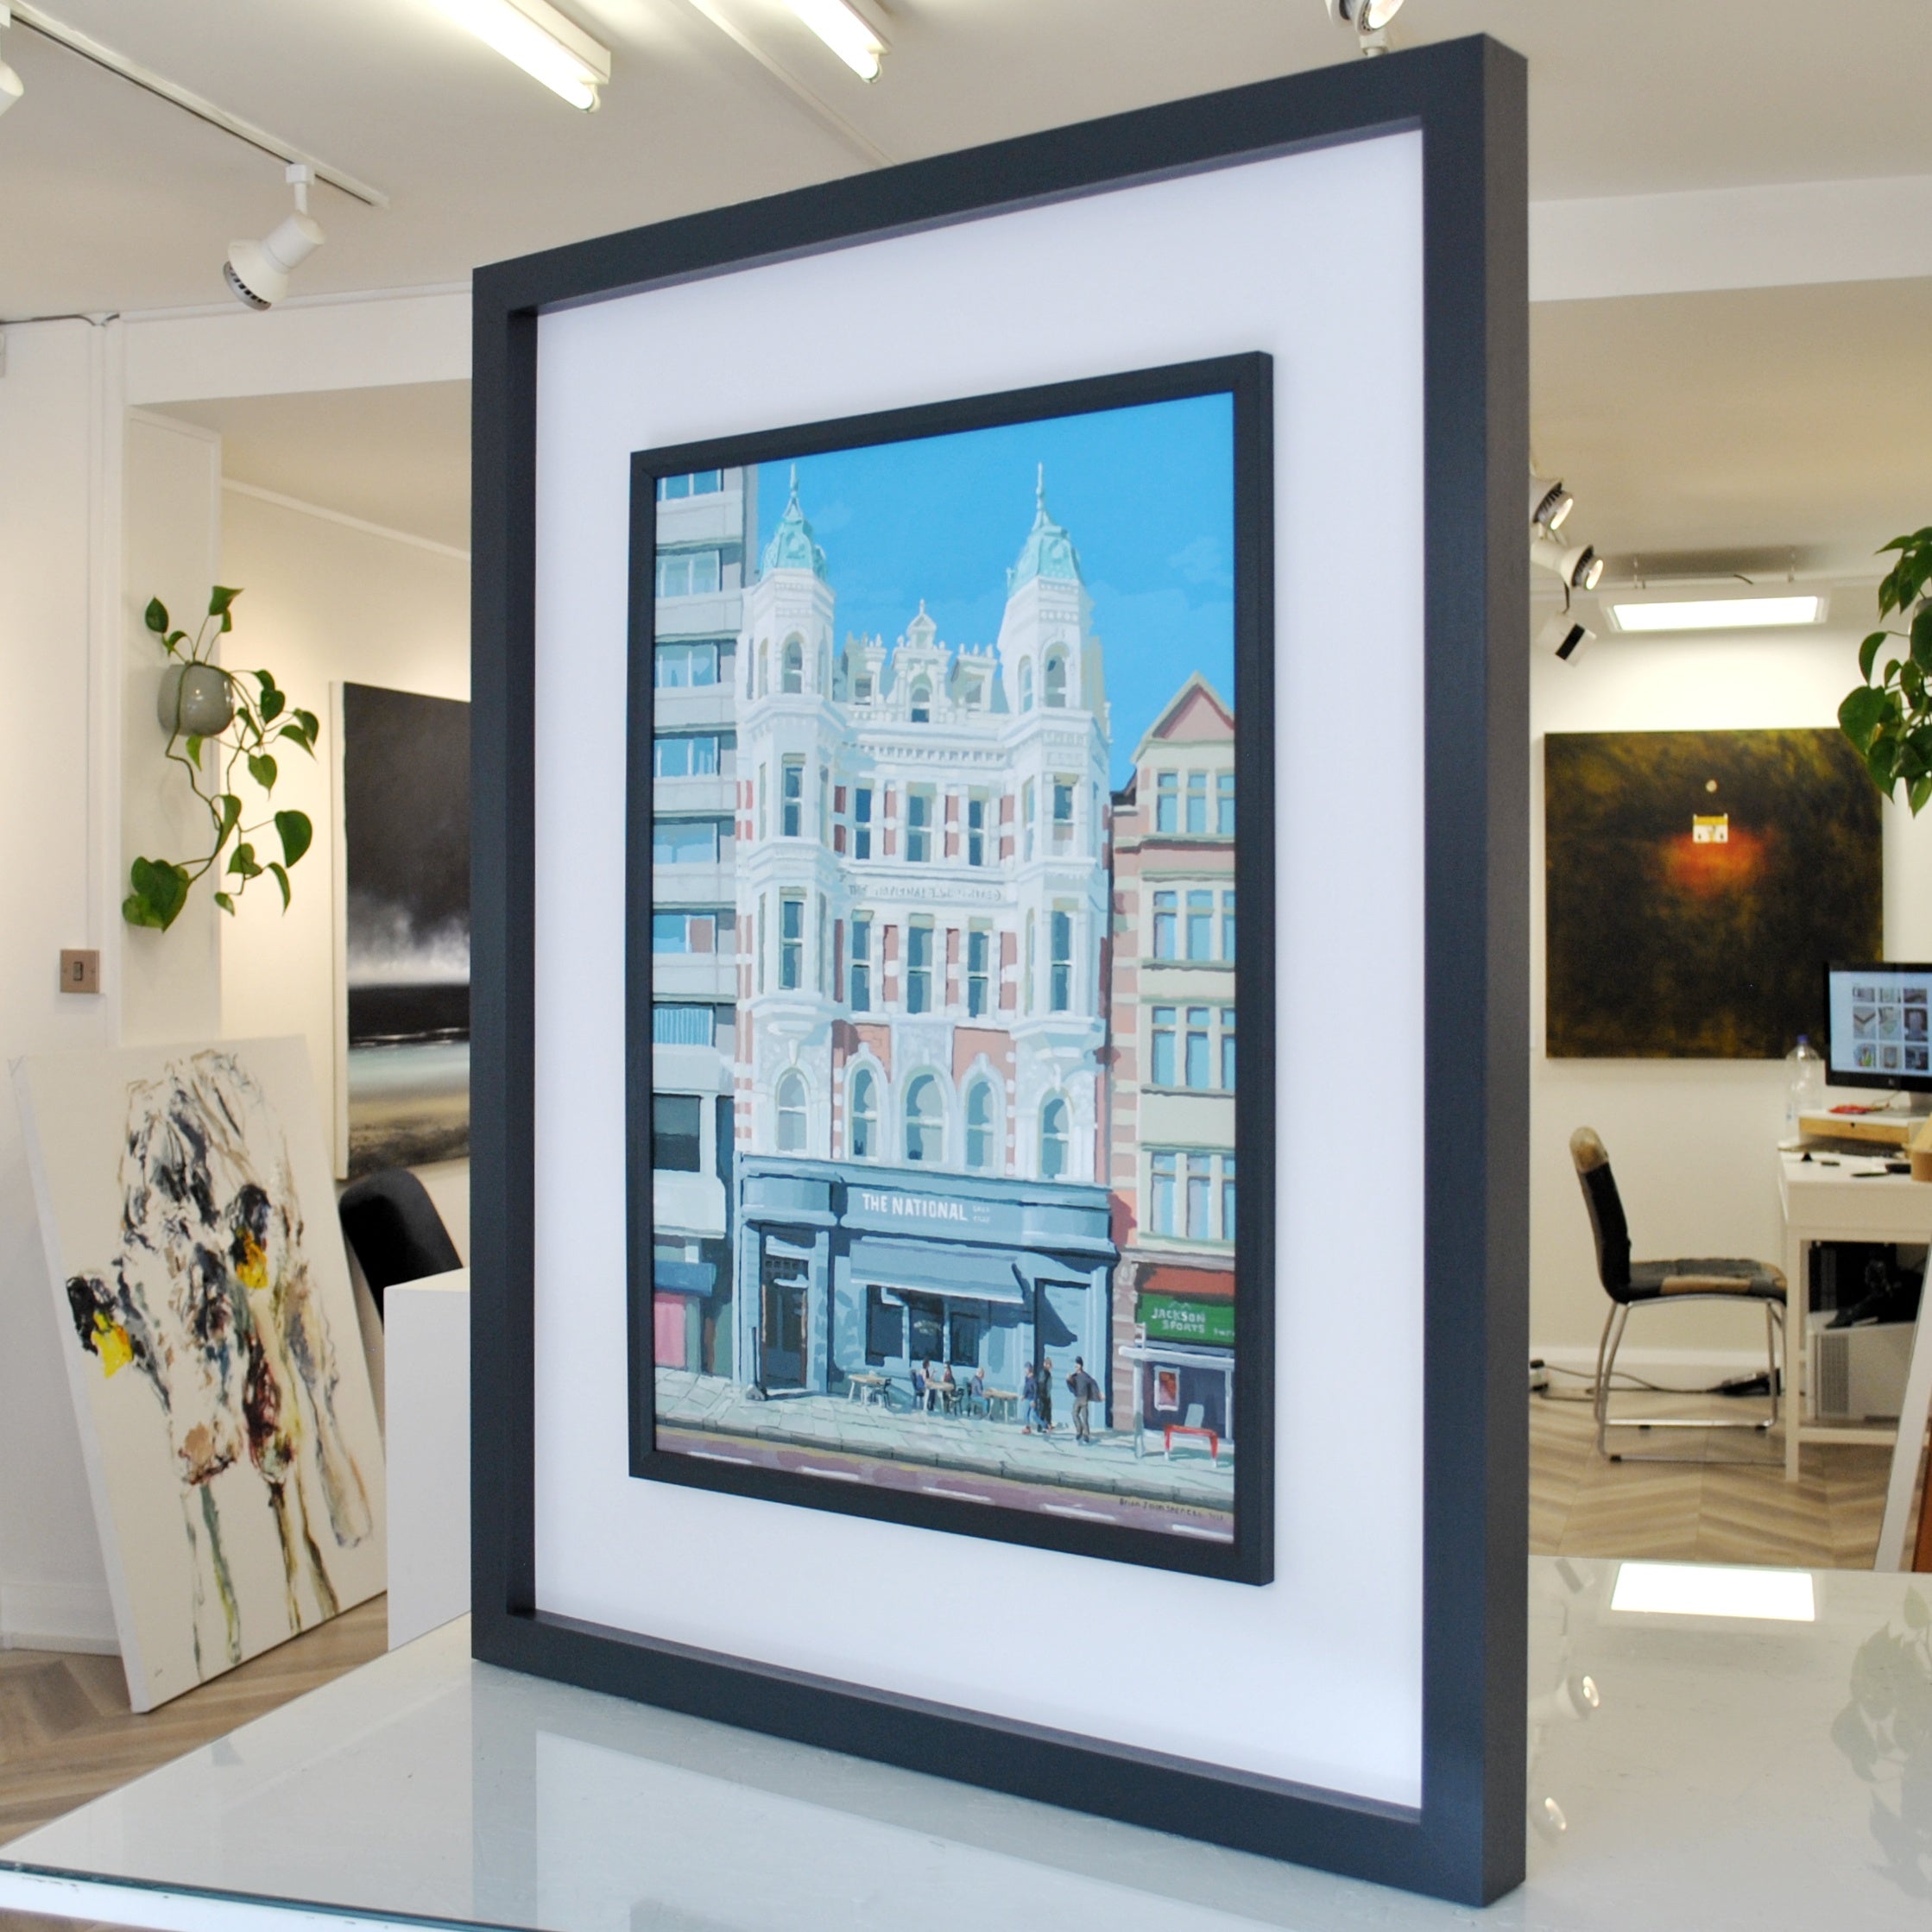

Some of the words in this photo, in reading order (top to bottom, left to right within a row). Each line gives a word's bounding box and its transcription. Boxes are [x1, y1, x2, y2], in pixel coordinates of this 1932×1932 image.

[862, 1193, 887, 1213] THE
[892, 1196, 968, 1222] NATIONAL
[1151, 1307, 1206, 1323] JACKSON
[1162, 1319, 1205, 1334] SPORTS
